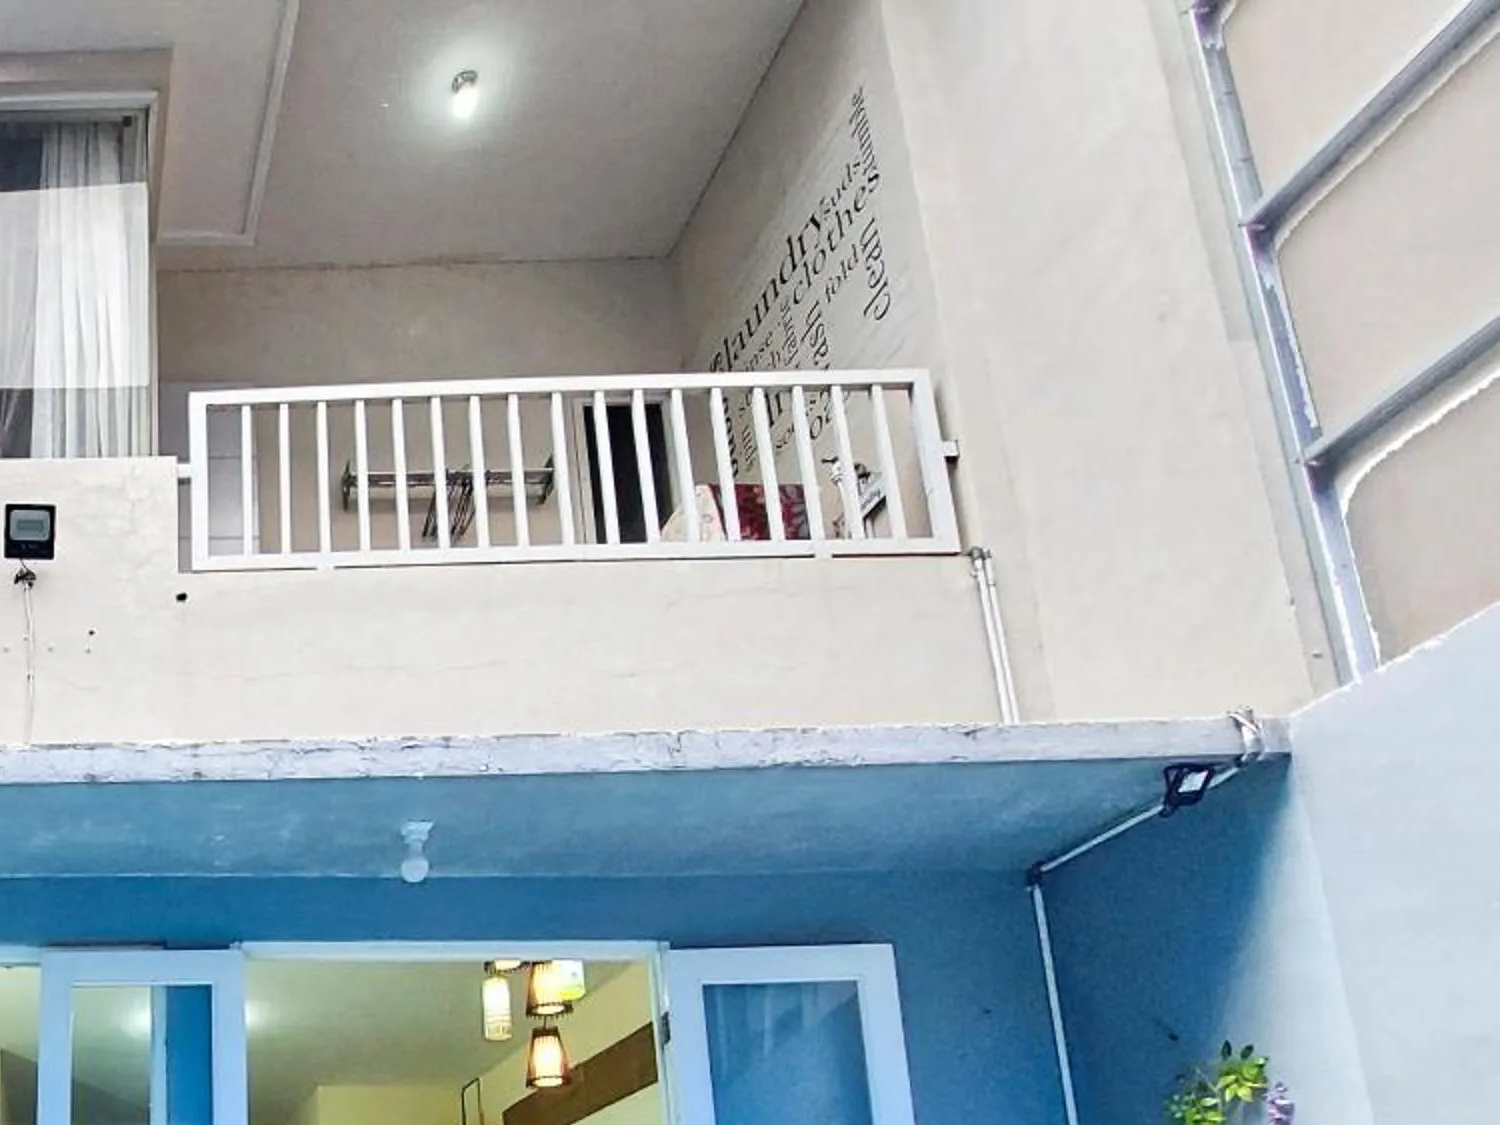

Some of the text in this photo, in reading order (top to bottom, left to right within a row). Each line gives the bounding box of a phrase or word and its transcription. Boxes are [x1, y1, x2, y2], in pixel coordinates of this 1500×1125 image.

[721, 212, 822, 372] laundry
[792, 172, 879, 305] clothes
[824, 243, 860, 303] fold
[859, 216, 892, 322] clean
